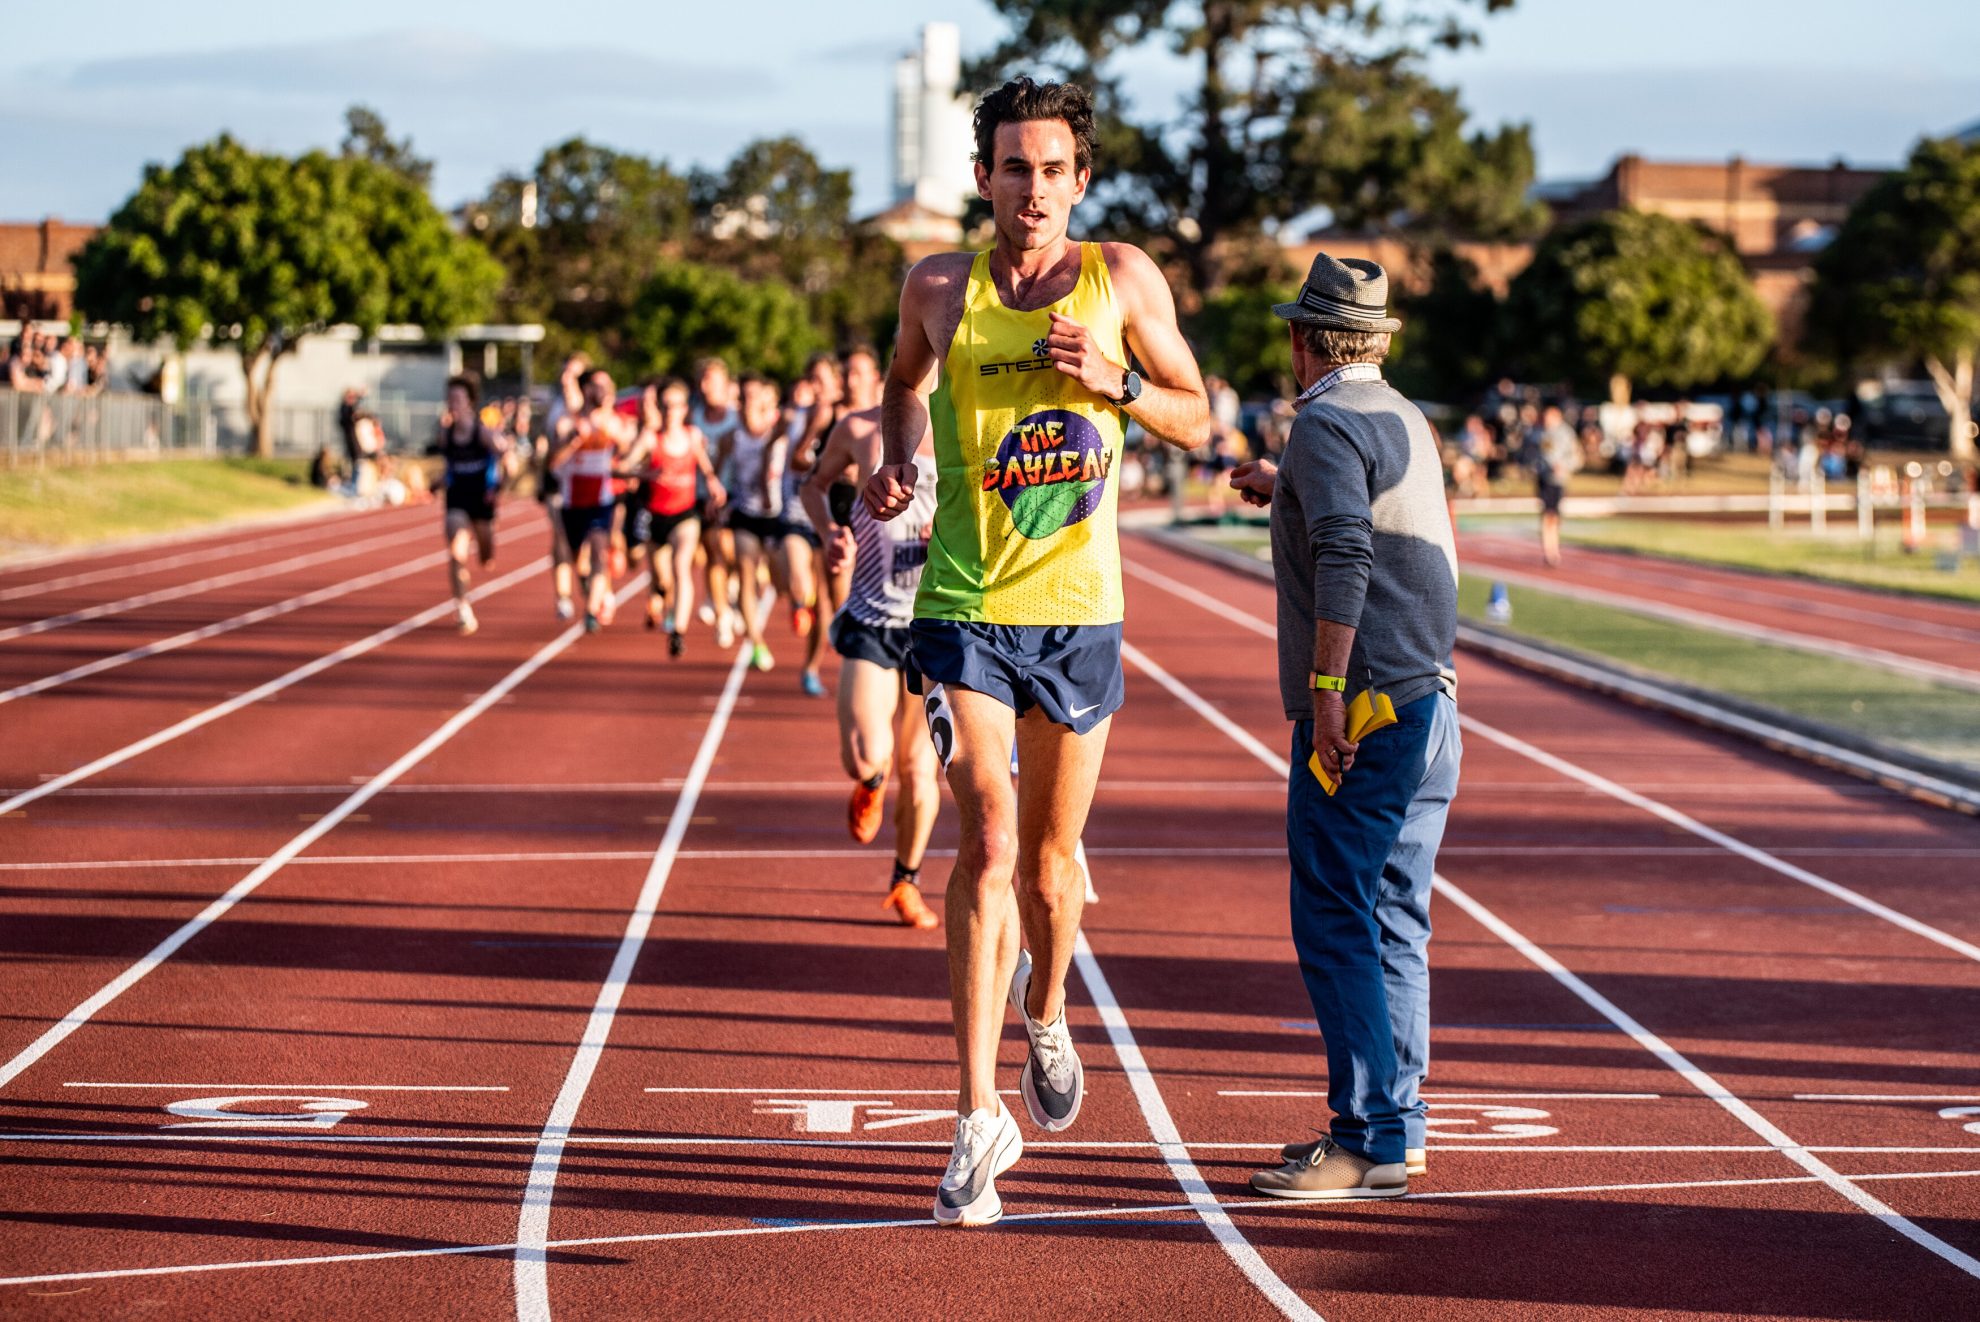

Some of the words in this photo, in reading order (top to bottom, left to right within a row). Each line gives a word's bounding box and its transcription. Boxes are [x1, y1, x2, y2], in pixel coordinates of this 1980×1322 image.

[979, 357, 1056, 376] STEI
[1011, 420, 1066, 453] THE
[981, 446, 1113, 492] BAYLEAF
